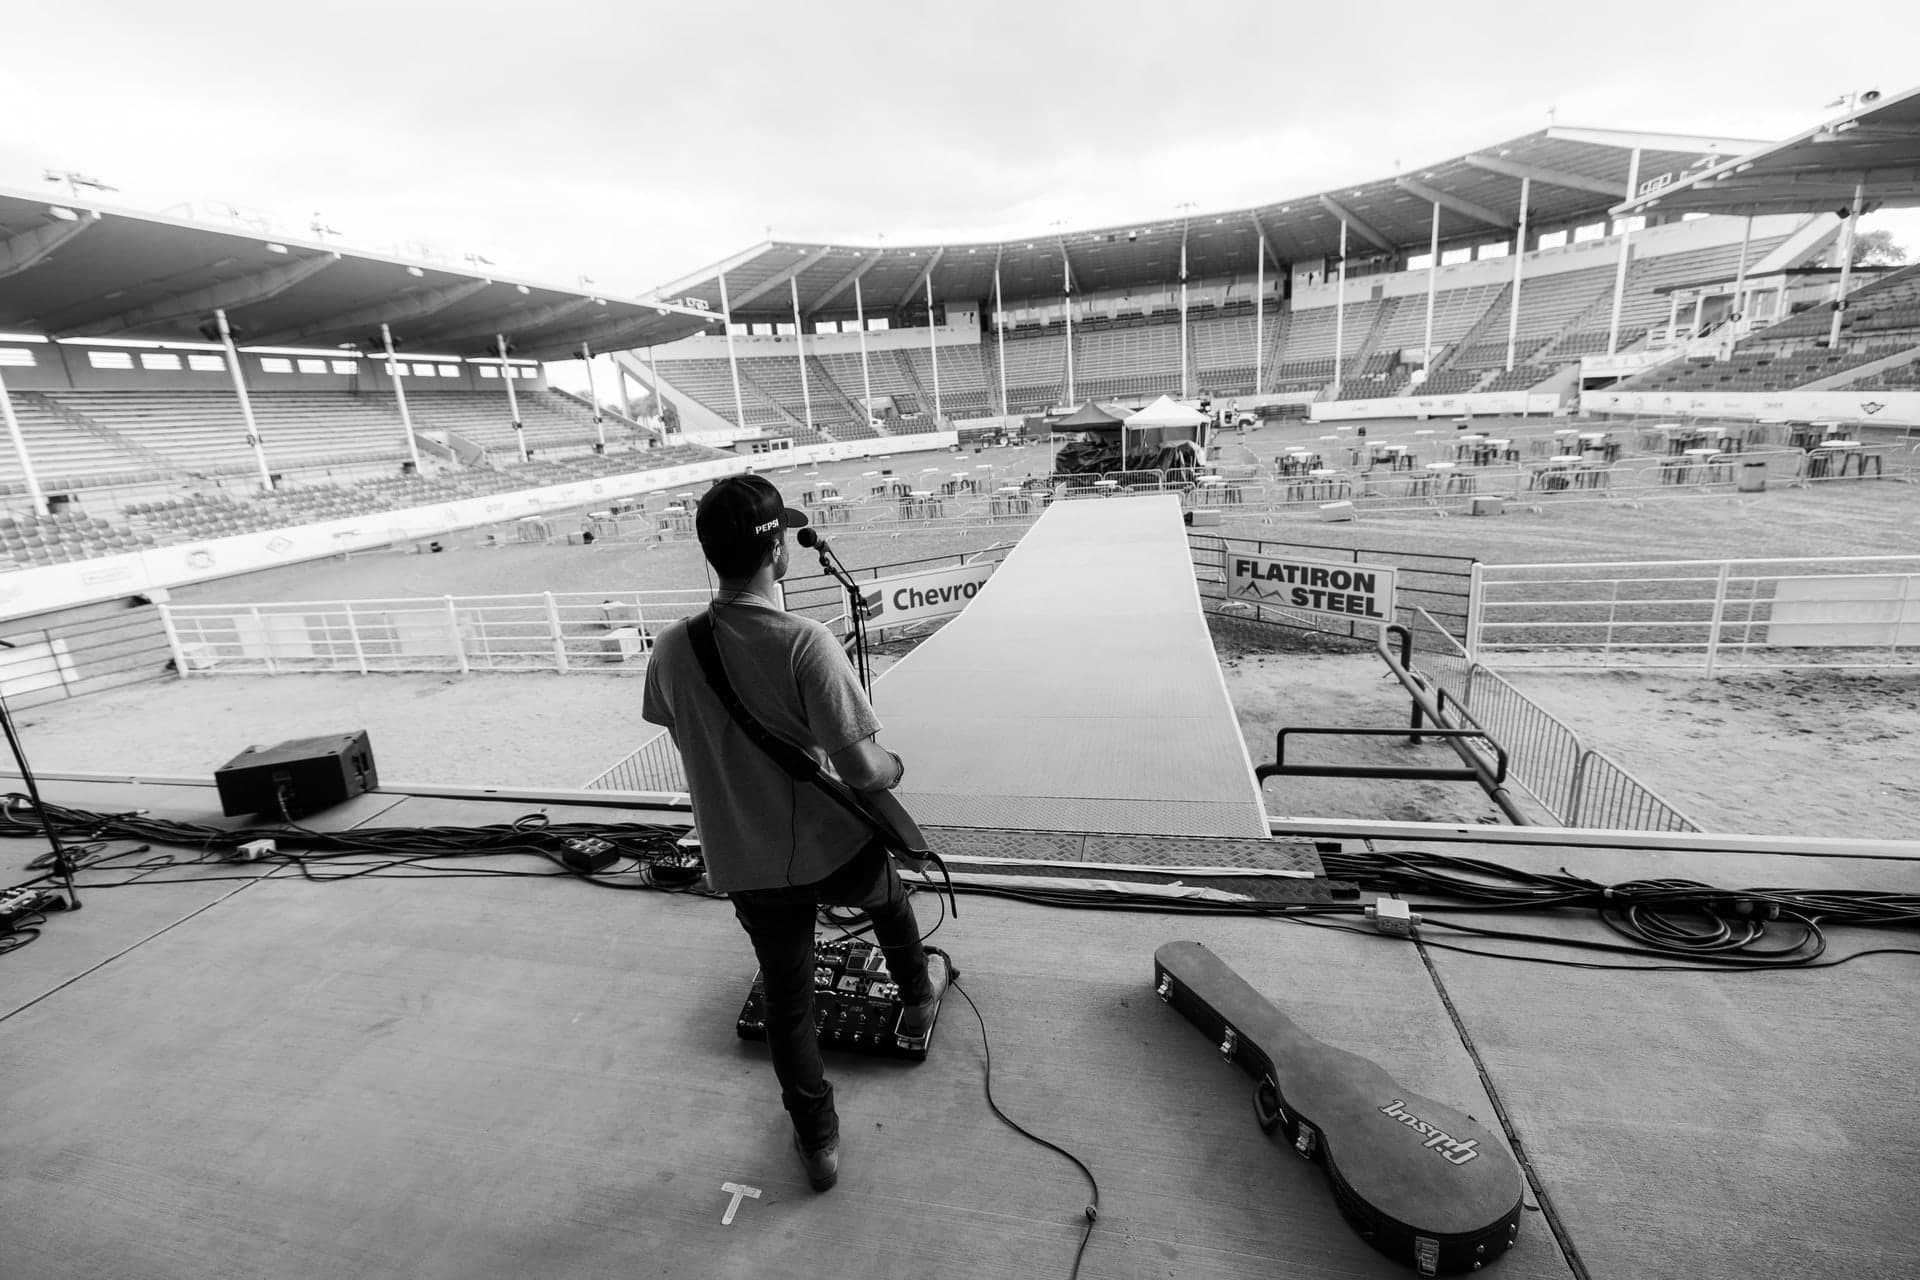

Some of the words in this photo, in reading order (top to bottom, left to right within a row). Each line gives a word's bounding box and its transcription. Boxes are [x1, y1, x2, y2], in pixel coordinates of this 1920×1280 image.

[755, 518, 779, 535] PEPSI
[1236, 559, 1376, 594] FLATIRON
[1290, 587, 1384, 618] STEEL
[1379, 1099, 1479, 1165] Gibson
